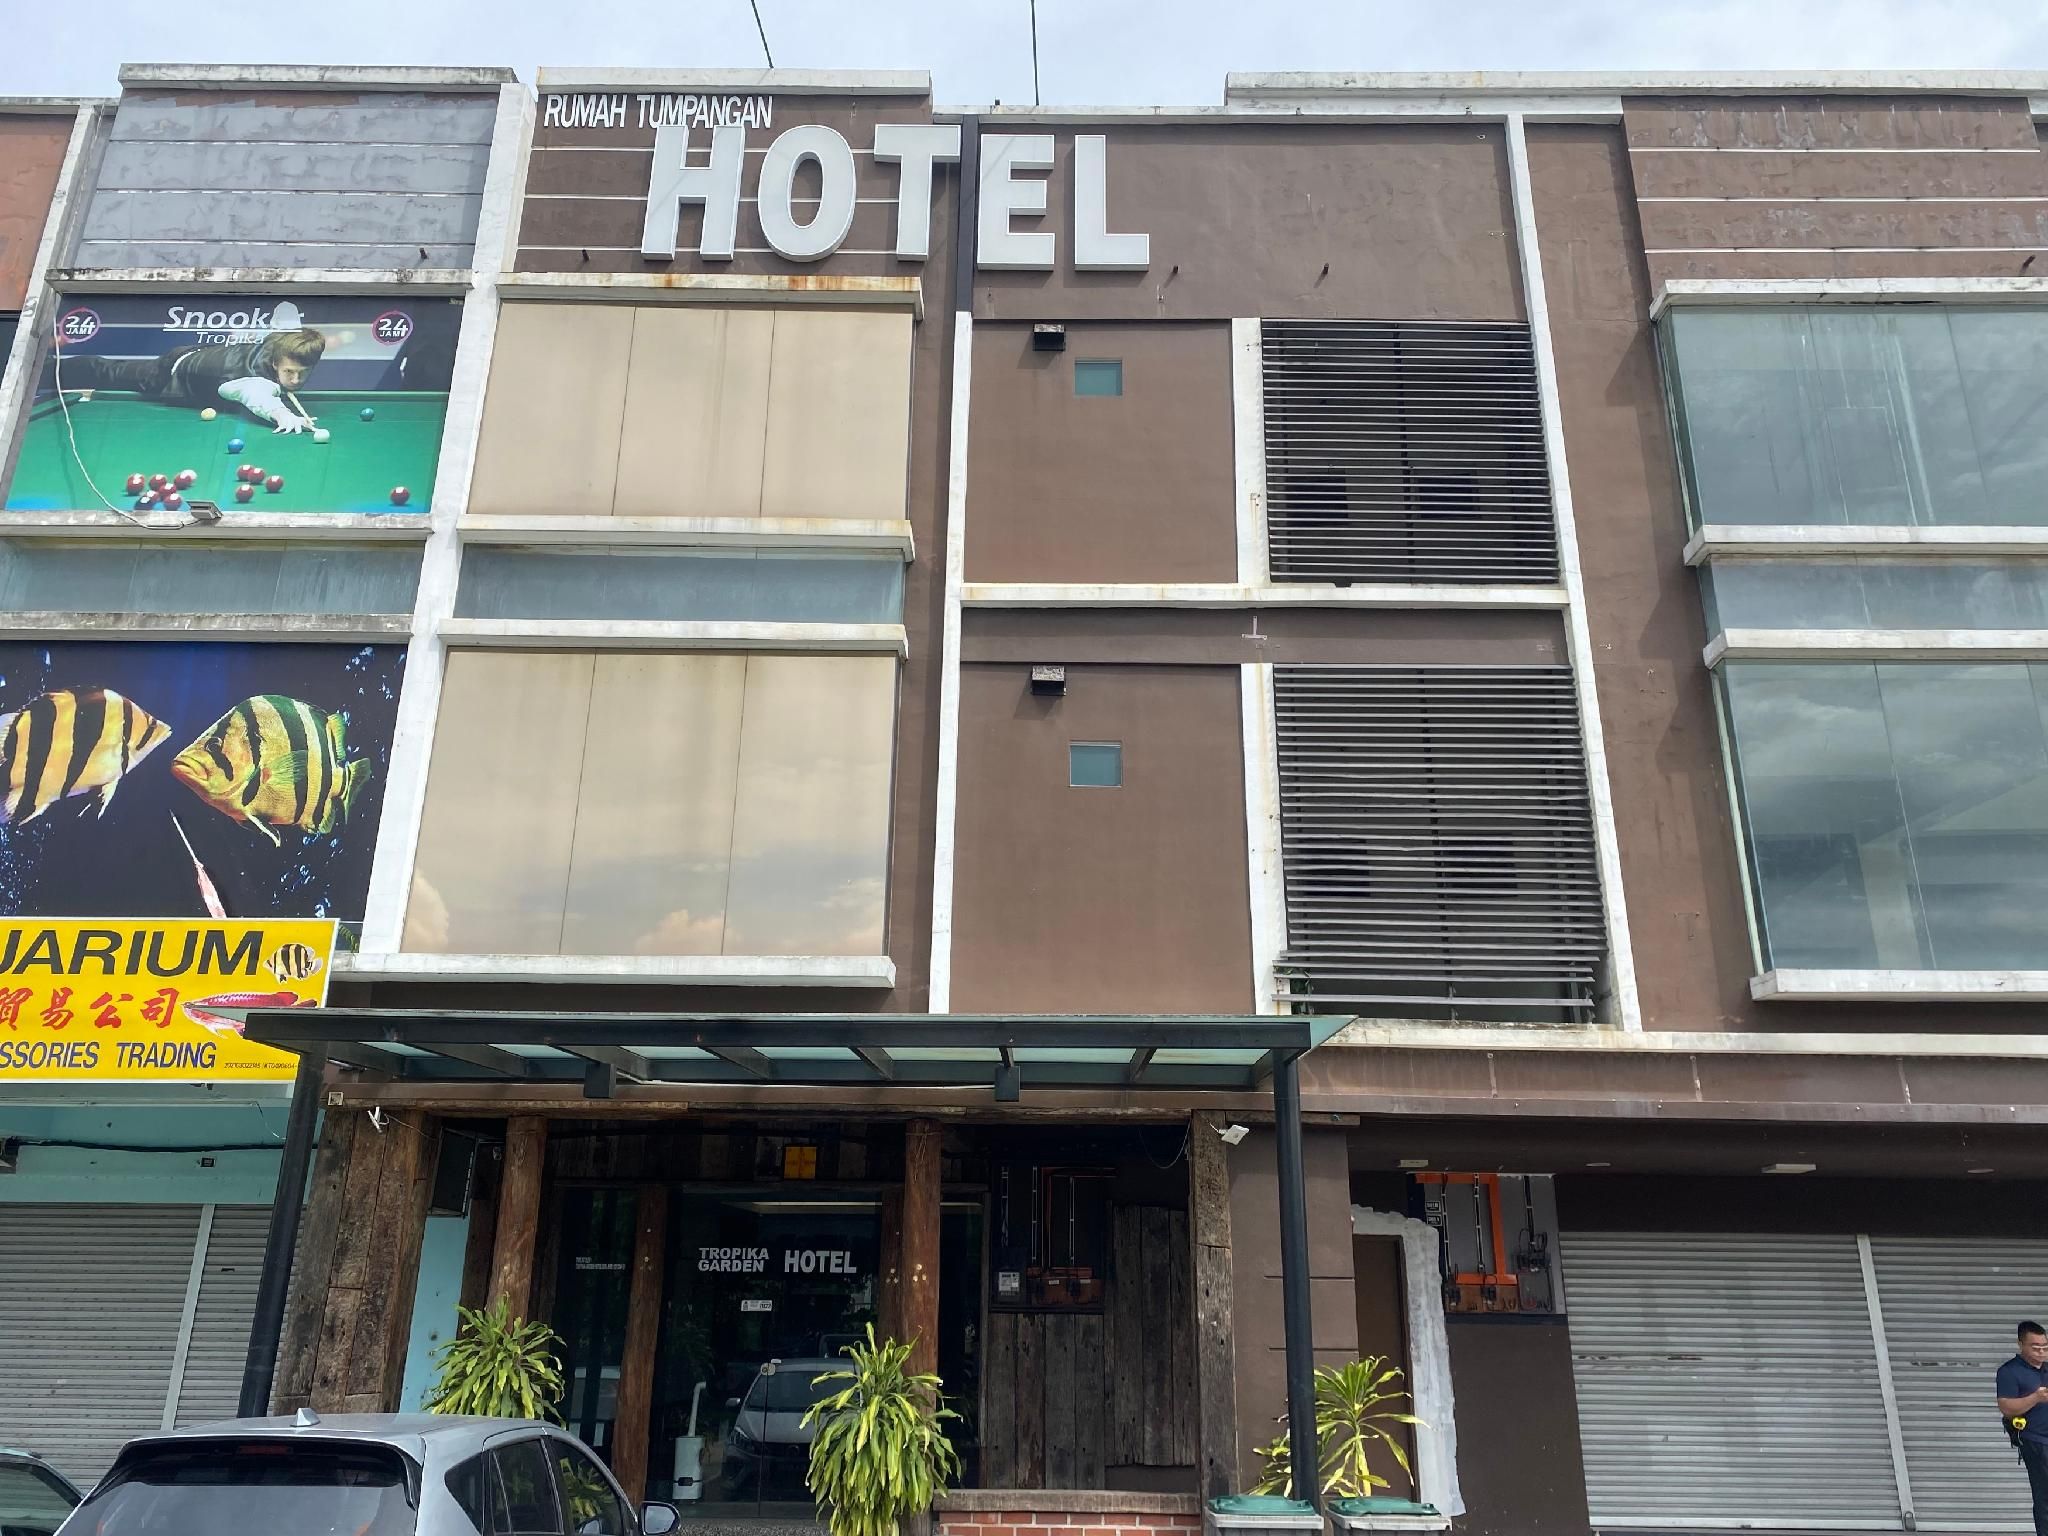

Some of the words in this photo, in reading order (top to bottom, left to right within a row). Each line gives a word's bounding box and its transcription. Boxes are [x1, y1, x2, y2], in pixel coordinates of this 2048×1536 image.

[543, 93, 628, 128] RUMAH
[636, 94, 773, 130] TUMPANGAN
[641, 124, 1149, 271] HOTEL
[65, 316, 96, 335] 24
[163, 306, 304, 329] Snook
[378, 318, 409, 337] 24
[197, 331, 270, 347] Tropika
[116, 1041, 217, 1069] TRADING
[699, 1247, 769, 1260] TROPIKA
[784, 1250, 857, 1274] HOTEL
[698, 1259, 764, 1272] GARDEN
